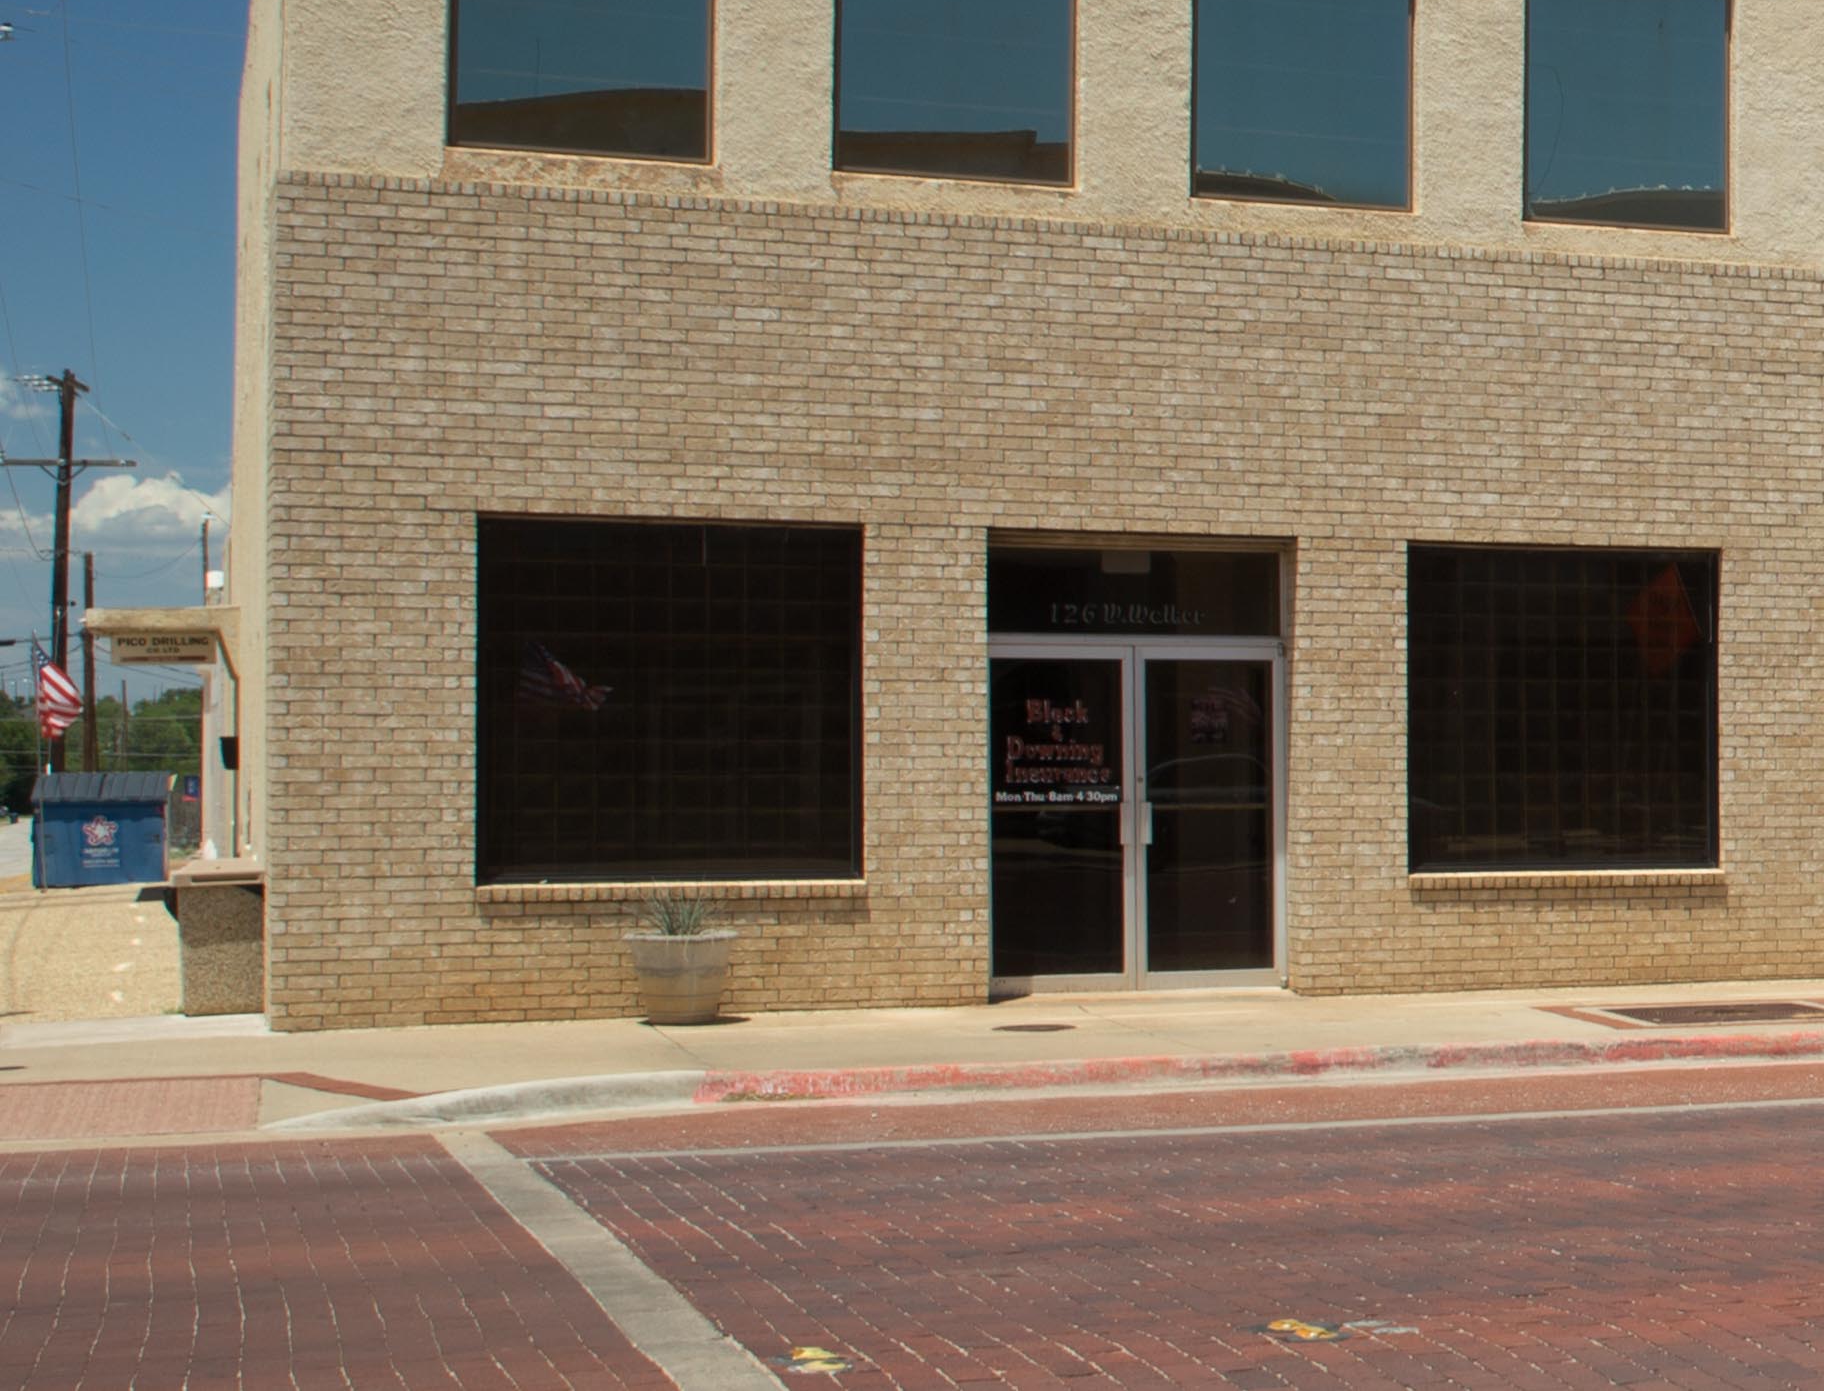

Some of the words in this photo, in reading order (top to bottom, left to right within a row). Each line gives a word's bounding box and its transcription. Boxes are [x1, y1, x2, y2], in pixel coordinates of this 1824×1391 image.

[1049, 602, 1096, 624] 126
[118, 637, 147, 647] PICO
[152, 636, 209, 646] DRILLING
[1006, 735, 1105, 766] Downing
[1005, 760, 1112, 784] Insurance
